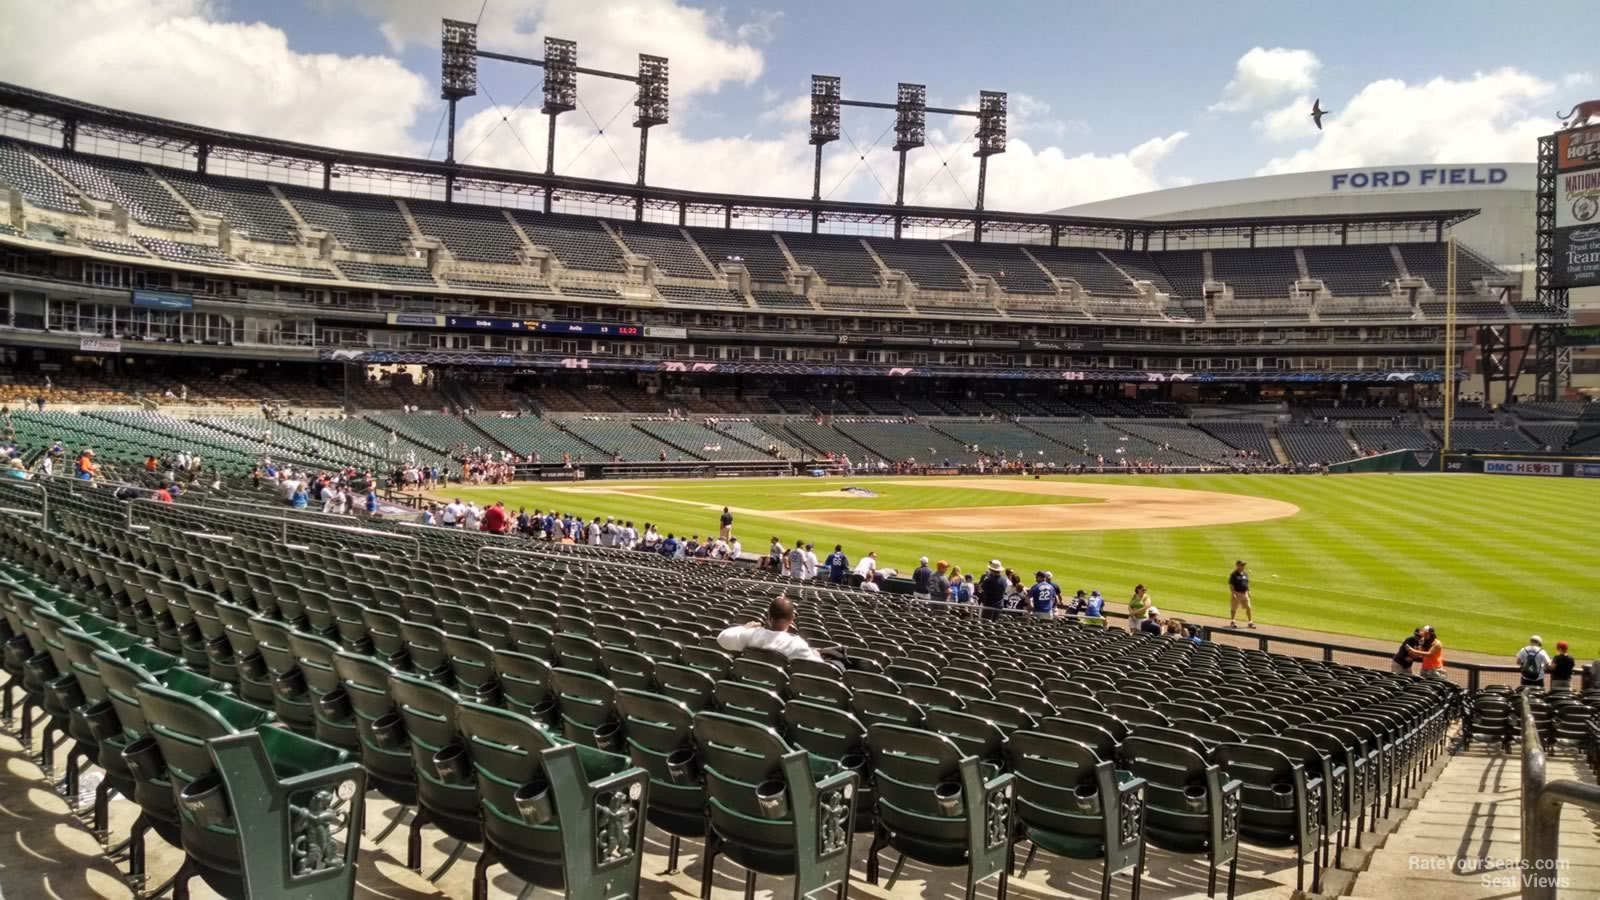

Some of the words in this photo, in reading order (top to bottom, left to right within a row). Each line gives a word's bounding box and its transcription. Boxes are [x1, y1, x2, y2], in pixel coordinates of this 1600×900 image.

[1332, 171, 1410, 190] FORD
[1419, 168, 1508, 185] FIELD
[1487, 462, 1513, 472] DMC
[1039, 591, 1050, 600] 22
[1008, 600, 1019, 609] 37
